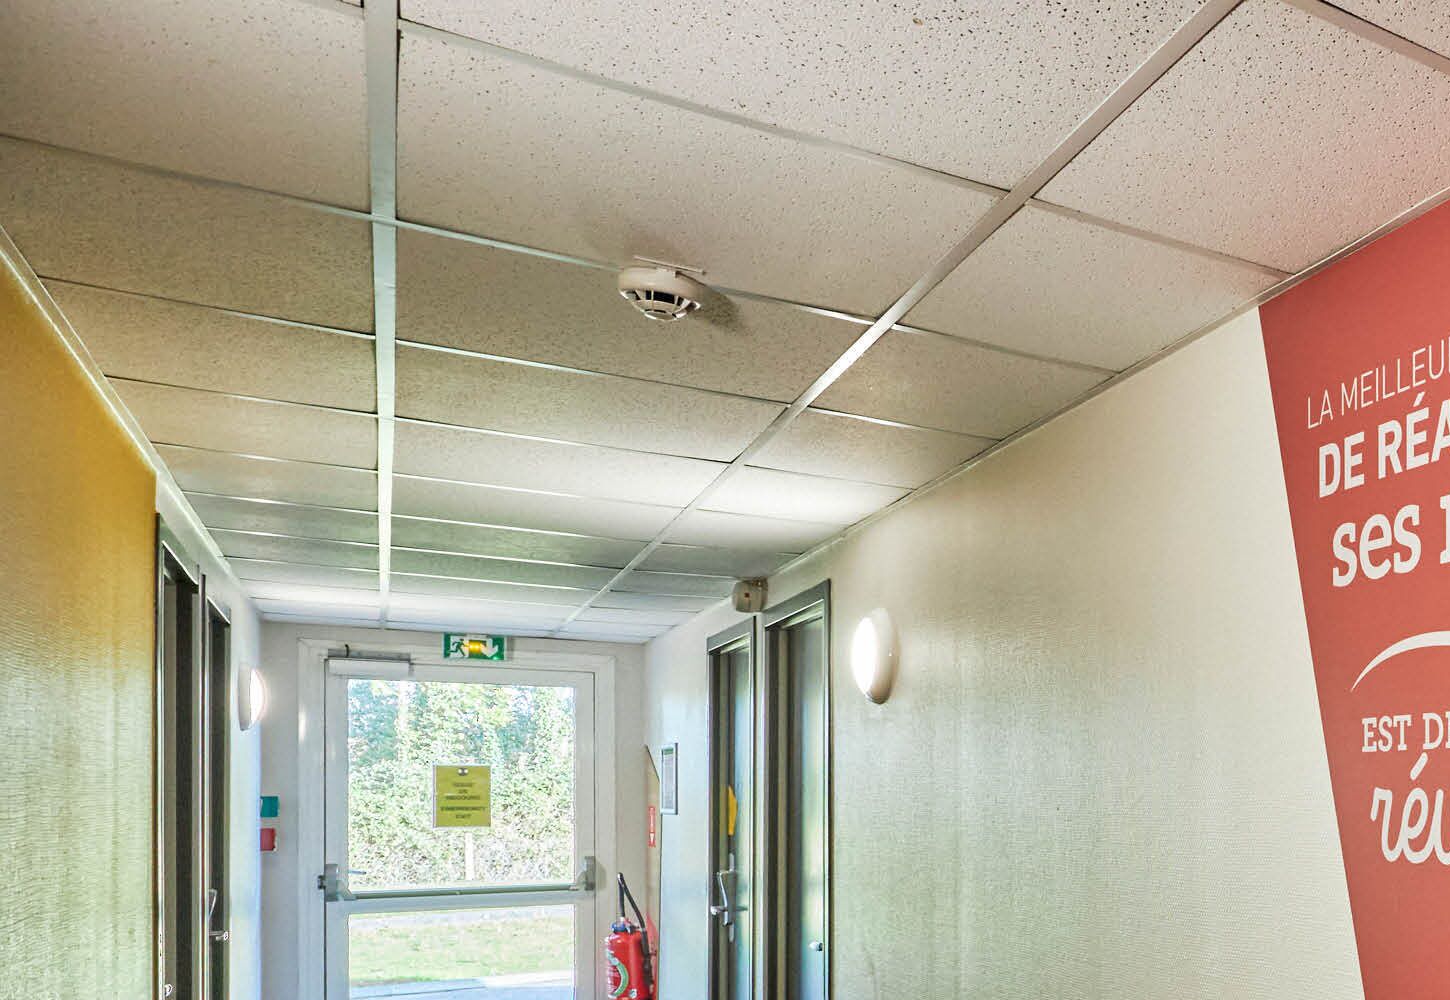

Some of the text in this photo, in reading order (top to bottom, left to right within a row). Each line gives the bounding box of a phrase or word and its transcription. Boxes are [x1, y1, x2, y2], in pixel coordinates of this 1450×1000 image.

[1307, 391, 1333, 429] LA
[1318, 431, 1365, 498] DE
[1332, 504, 1422, 587] ses
[1361, 712, 1413, 753] EST
